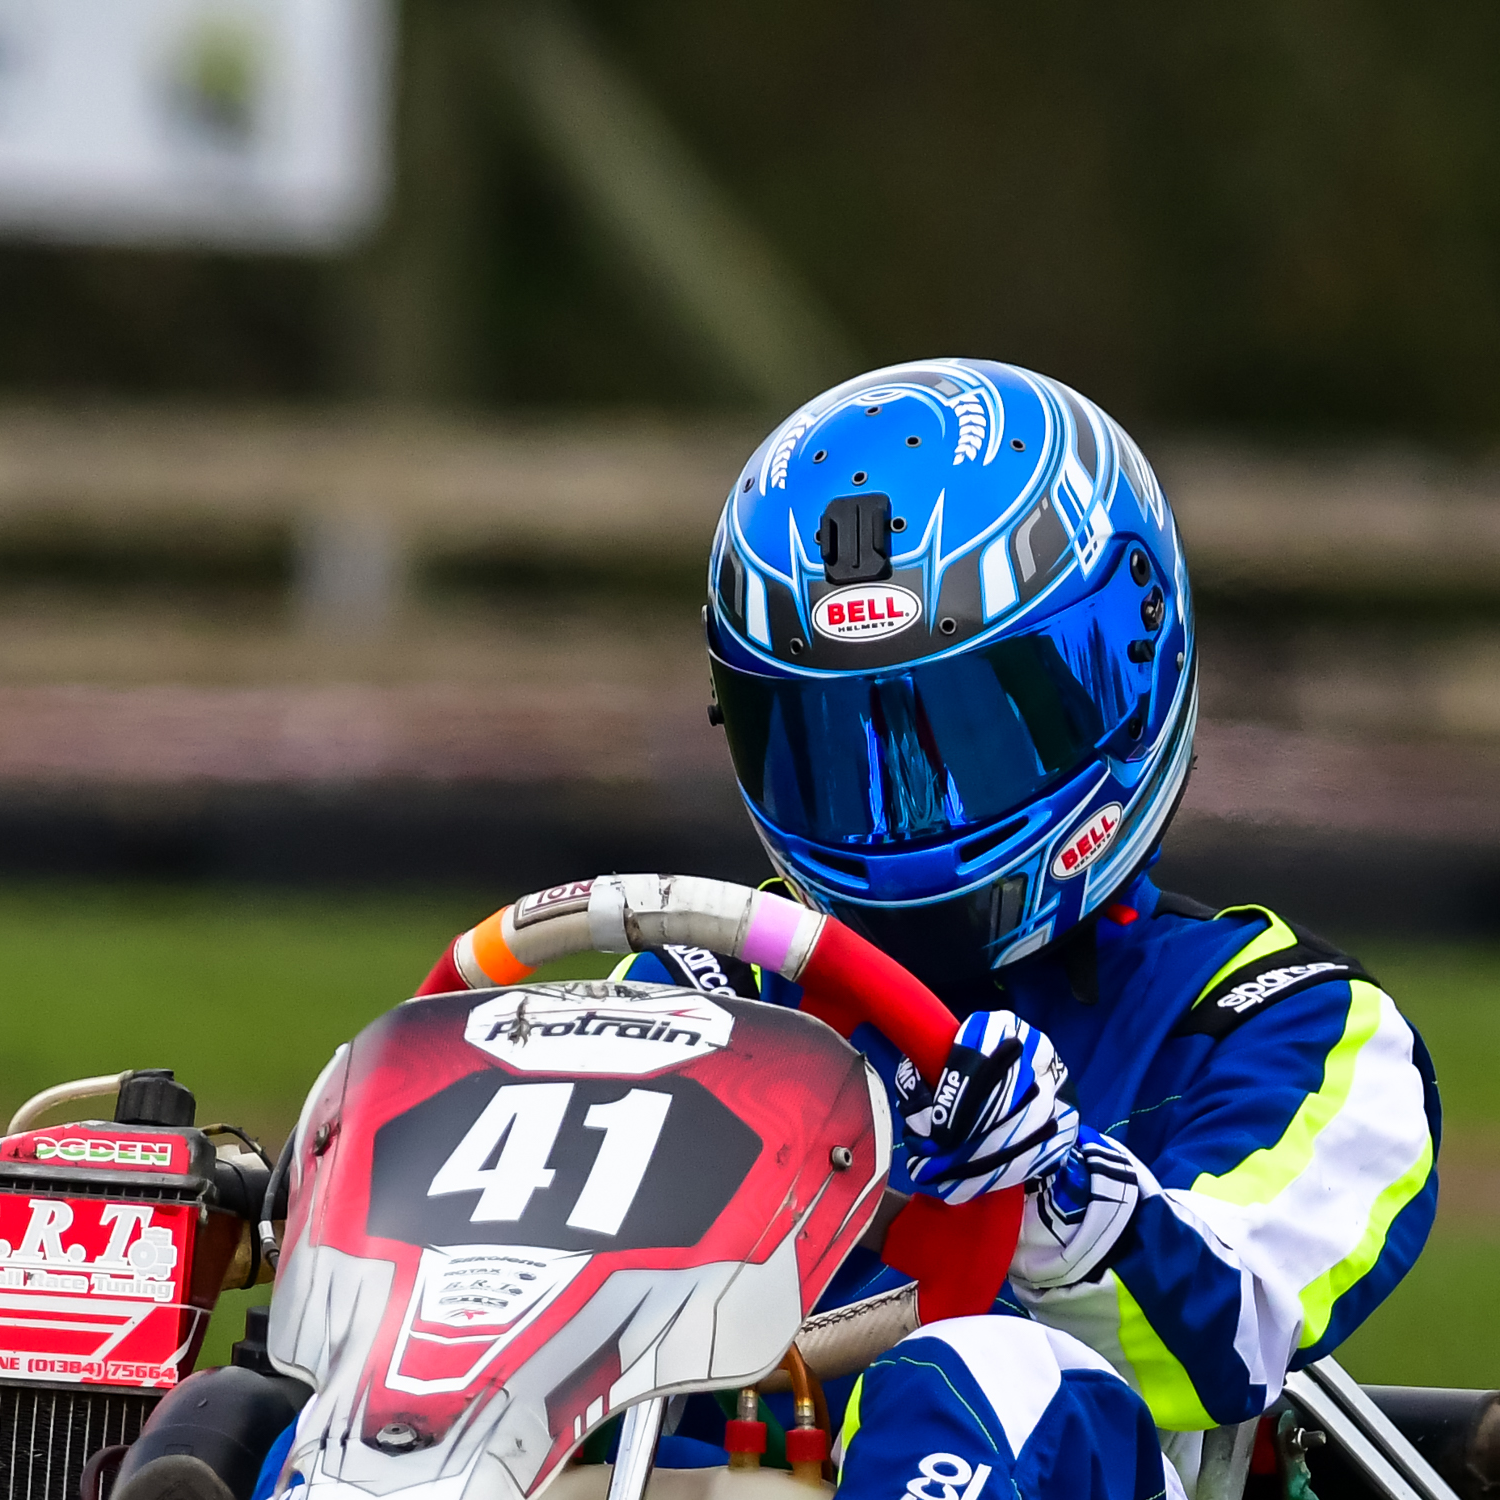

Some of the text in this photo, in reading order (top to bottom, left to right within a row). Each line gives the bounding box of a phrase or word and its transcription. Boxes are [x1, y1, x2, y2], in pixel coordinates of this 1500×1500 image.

[827, 597, 904, 626] BELL
[838, 621, 895, 633] HELMETS
[1061, 815, 1115, 871] BELL
[931, 1069, 963, 1126] OMP
[427, 1083, 673, 1236] 41
[29, 1270, 89, 1294] Race
[90, 1273, 176, 1302] Tuning
[27, 1357, 105, 1379] (01384)
[109, 1363, 178, 1381] 75664
